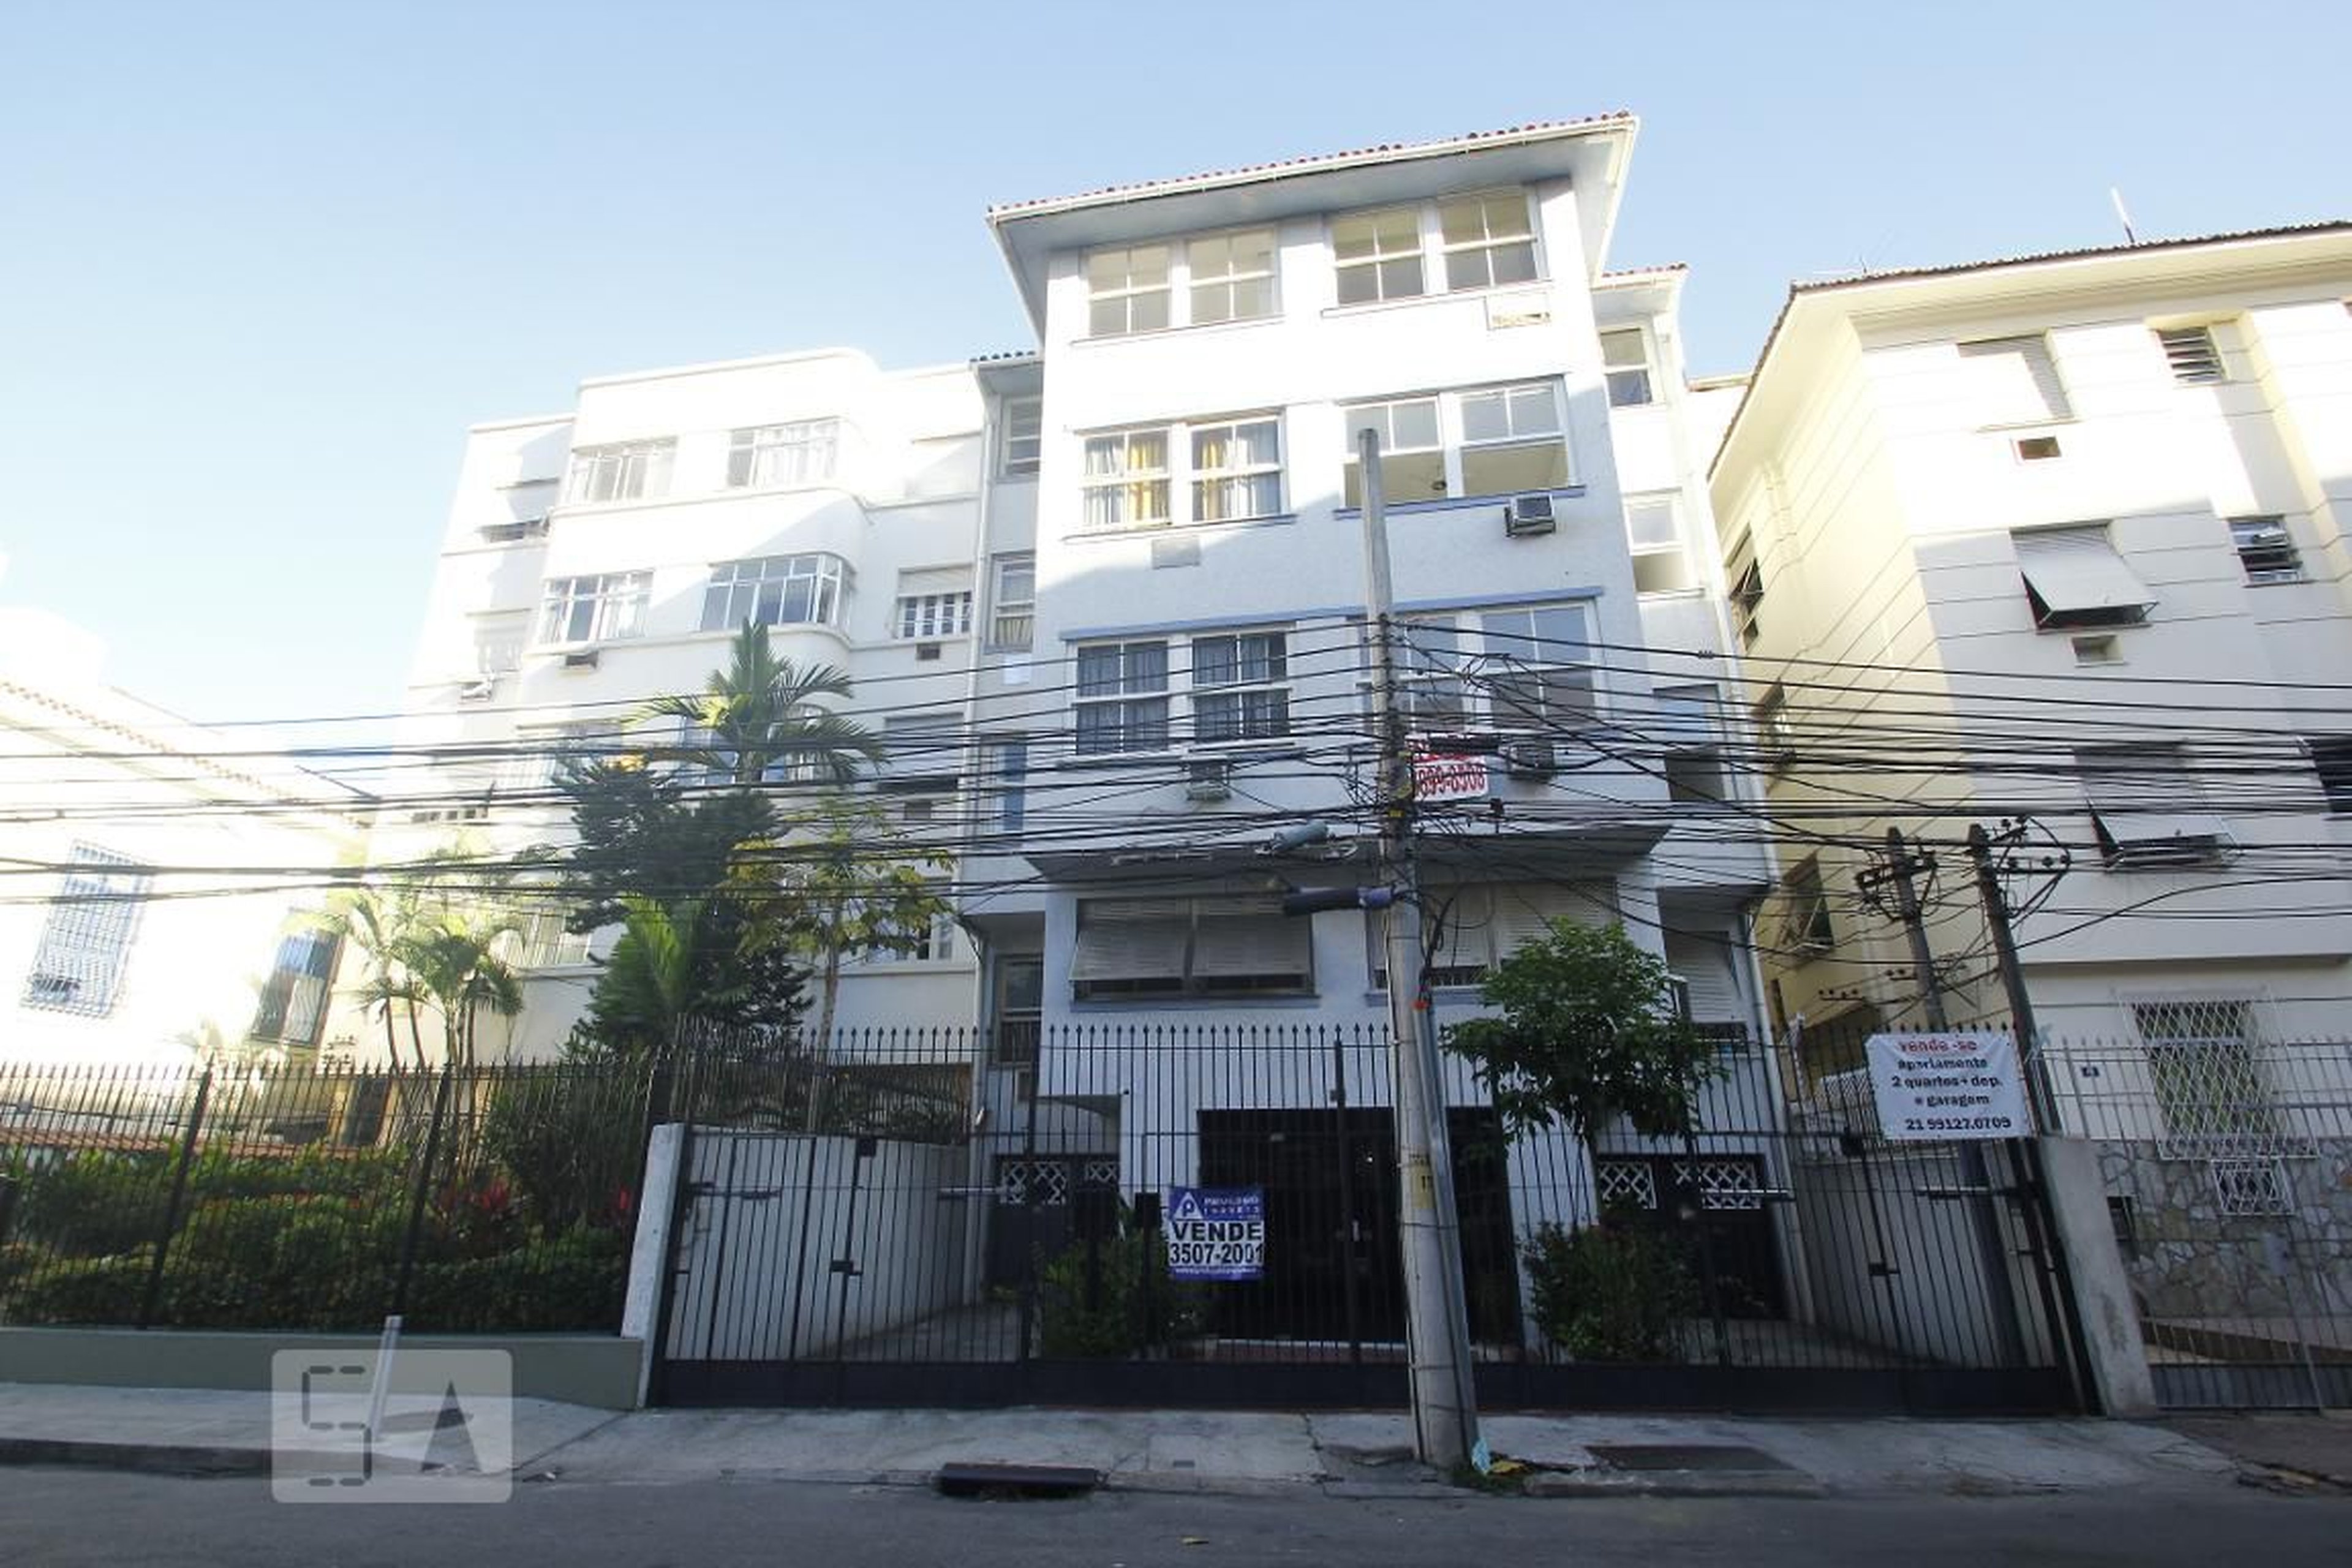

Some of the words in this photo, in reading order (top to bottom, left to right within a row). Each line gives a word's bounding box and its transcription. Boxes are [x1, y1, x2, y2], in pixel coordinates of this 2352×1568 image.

[1891, 1076, 1901, 1087] 2
[1926, 1094, 1991, 1107] garagem
[1905, 1118, 1924, 1131] 21
[1172, 1222, 1262, 1242] VENDE
[1170, 1242, 1264, 1264] 3507-2001
